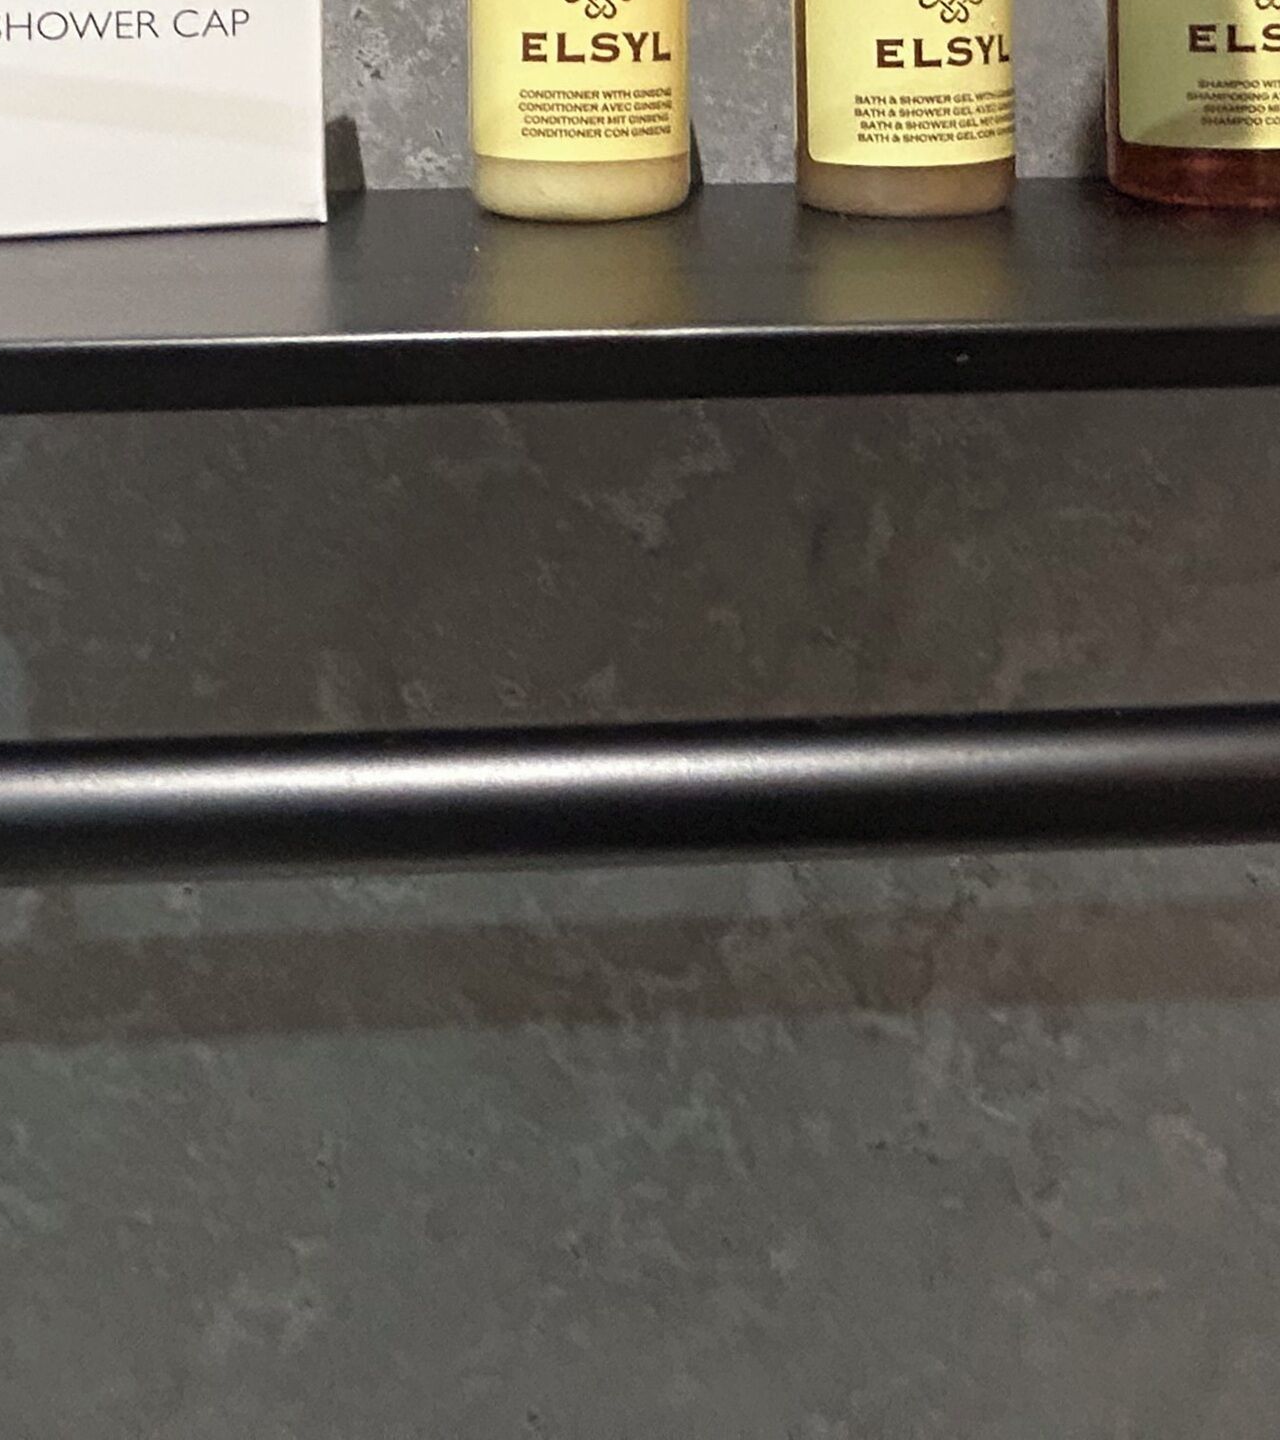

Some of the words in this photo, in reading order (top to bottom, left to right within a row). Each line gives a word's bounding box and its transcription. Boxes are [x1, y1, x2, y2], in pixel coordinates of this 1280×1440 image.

[173, 8, 250, 38] CAP
[521, 31, 672, 63] ELSYL
[876, 34, 1010, 69] ELSYL
[519, 89, 600, 99] CONDITIONER
[602, 90, 632, 99] WITH
[855, 94, 887, 104] BATH
[888, 95, 897, 104] &
[899, 94, 951, 105] SHOWER
[953, 93, 974, 103] GEL
[518, 101, 599, 112] CONDITIONER
[601, 101, 632, 112] AVEC
[854, 108, 885, 117] BATH
[888, 108, 896, 117] &
[899, 107, 951, 118] SHOWER
[953, 106, 973, 116] GEL
[523, 114, 605, 125] CONDITIONER
[607, 114, 626, 124] MIT
[860, 120, 892, 130] BATH
[895, 120, 903, 130] &
[905, 119, 957, 130] SHOWER
[958, 118, 978, 128] GEL
[521, 127, 602, 138] CONDITIONER
[604, 127, 629, 137] CON
[857, 133, 889, 142] BATH
[891, 133, 900, 142] &
[903, 131, 954, 143] SHOWER
[956, 130, 977, 141] GEL
